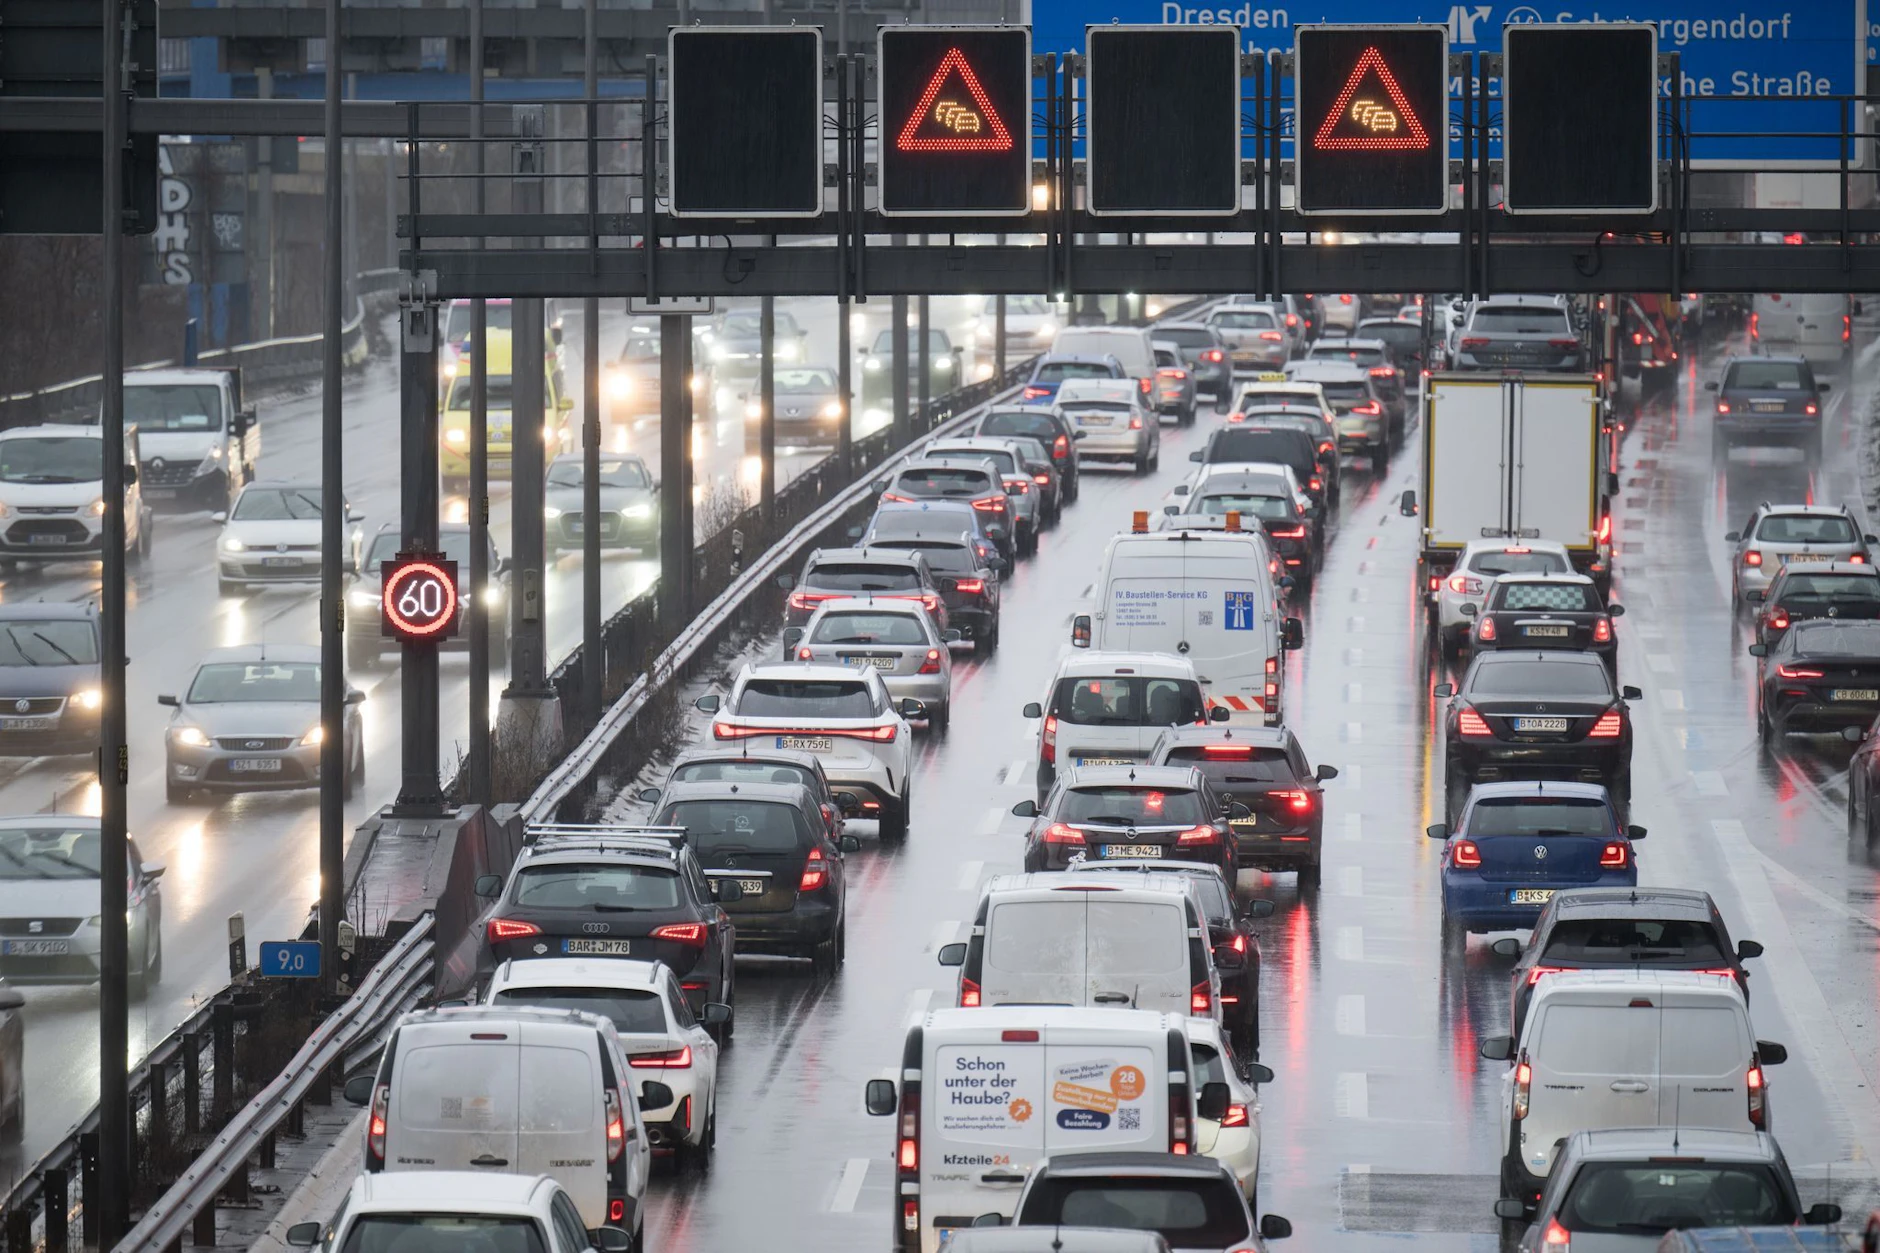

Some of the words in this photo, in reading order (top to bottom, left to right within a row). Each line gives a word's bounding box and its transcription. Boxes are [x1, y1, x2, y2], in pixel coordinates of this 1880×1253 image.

[1162, 2, 1288, 28] Dresden
[1731, 71, 1831, 95] Straße
[398, 580, 442, 617] 60
[1544, 720, 1566, 728] 2228
[1136, 846, 1160, 856] 9421
[569, 941, 590, 952] BAR
[278, 949, 304, 971] 9,0
[956, 1056, 1005, 1071] Schon
[945, 1075, 986, 1088] unter
[990, 1073, 1017, 1088] der
[1119, 1071, 1136, 1084] 28
[951, 1090, 1011, 1105] Haube?
[1064, 1120, 1103, 1129] Bezahlung
[943, 1154, 1010, 1165] kfzteile24
